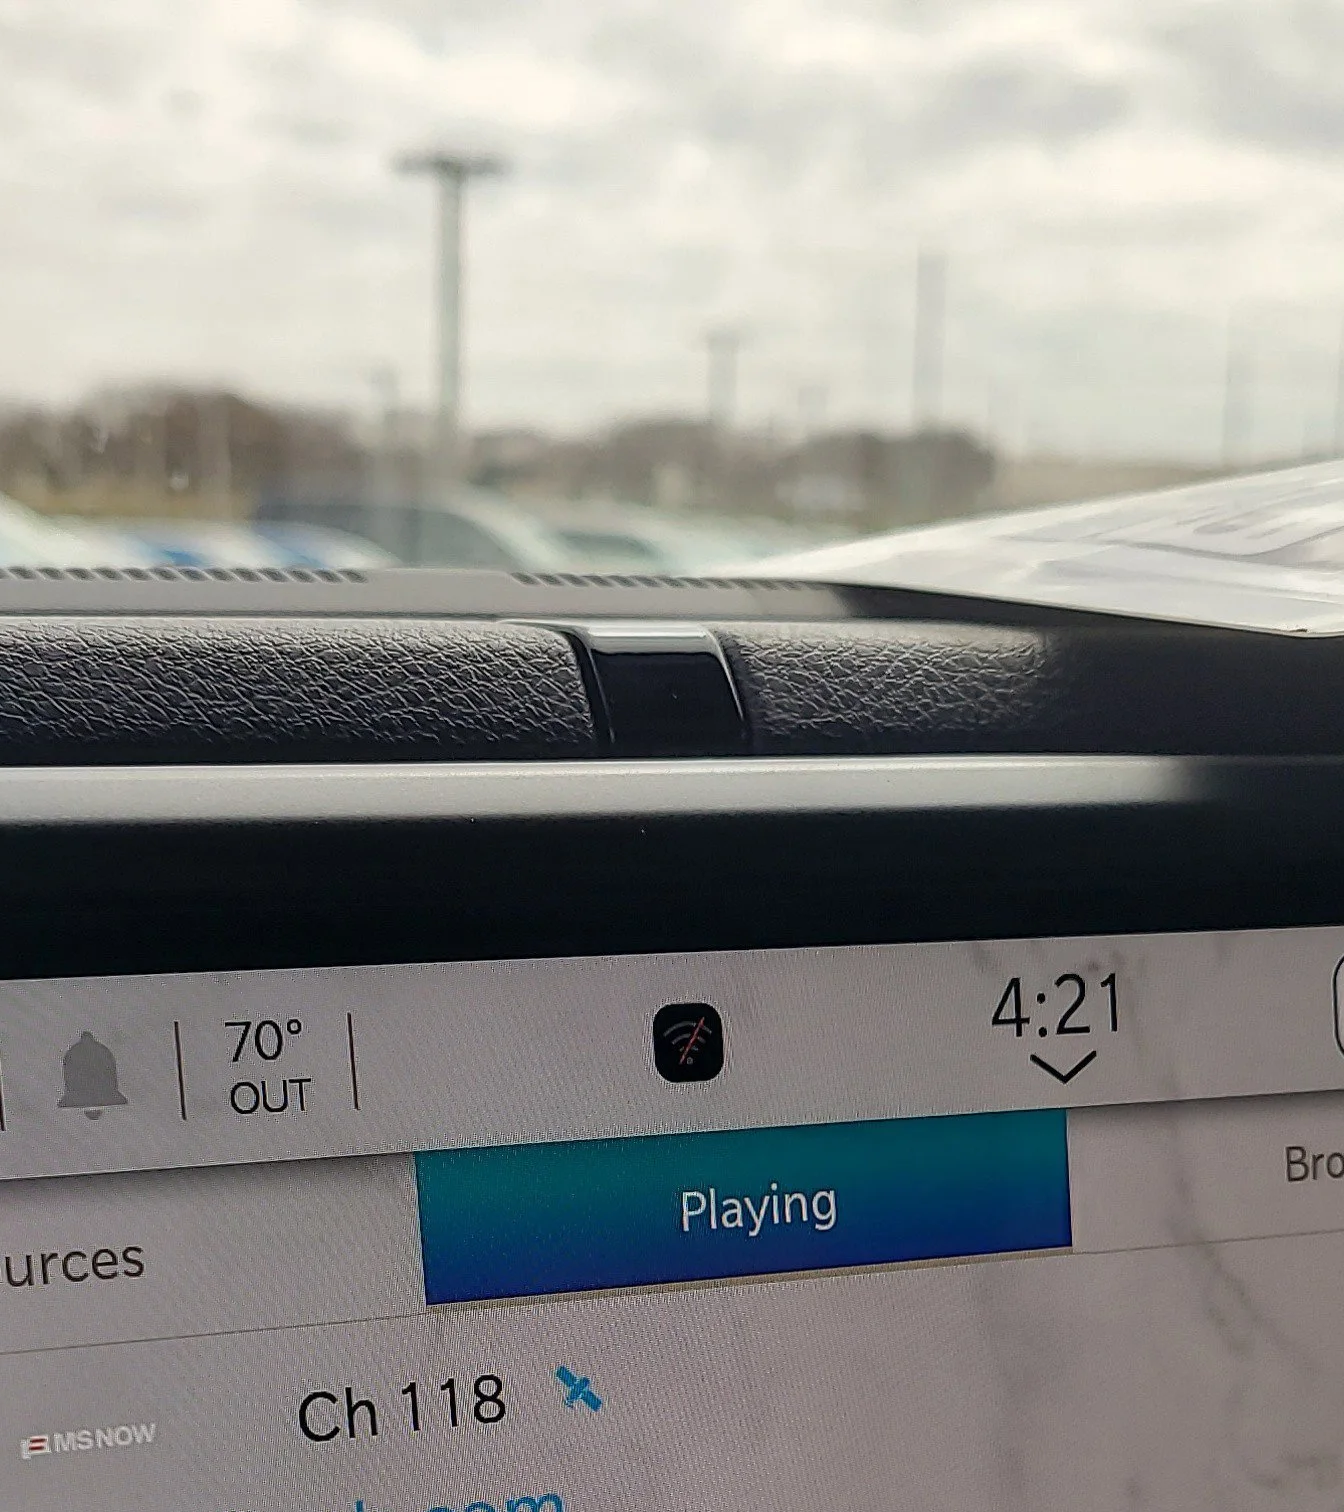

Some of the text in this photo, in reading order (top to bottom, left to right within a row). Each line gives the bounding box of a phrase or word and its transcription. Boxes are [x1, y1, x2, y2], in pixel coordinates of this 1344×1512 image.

[991, 972, 1120, 1038] 4:21
[223, 1017, 304, 1064] 70°
[229, 1077, 313, 1117] OUT
[680, 1183, 838, 1237] Playing
[297, 1374, 507, 1443] Ch 118
